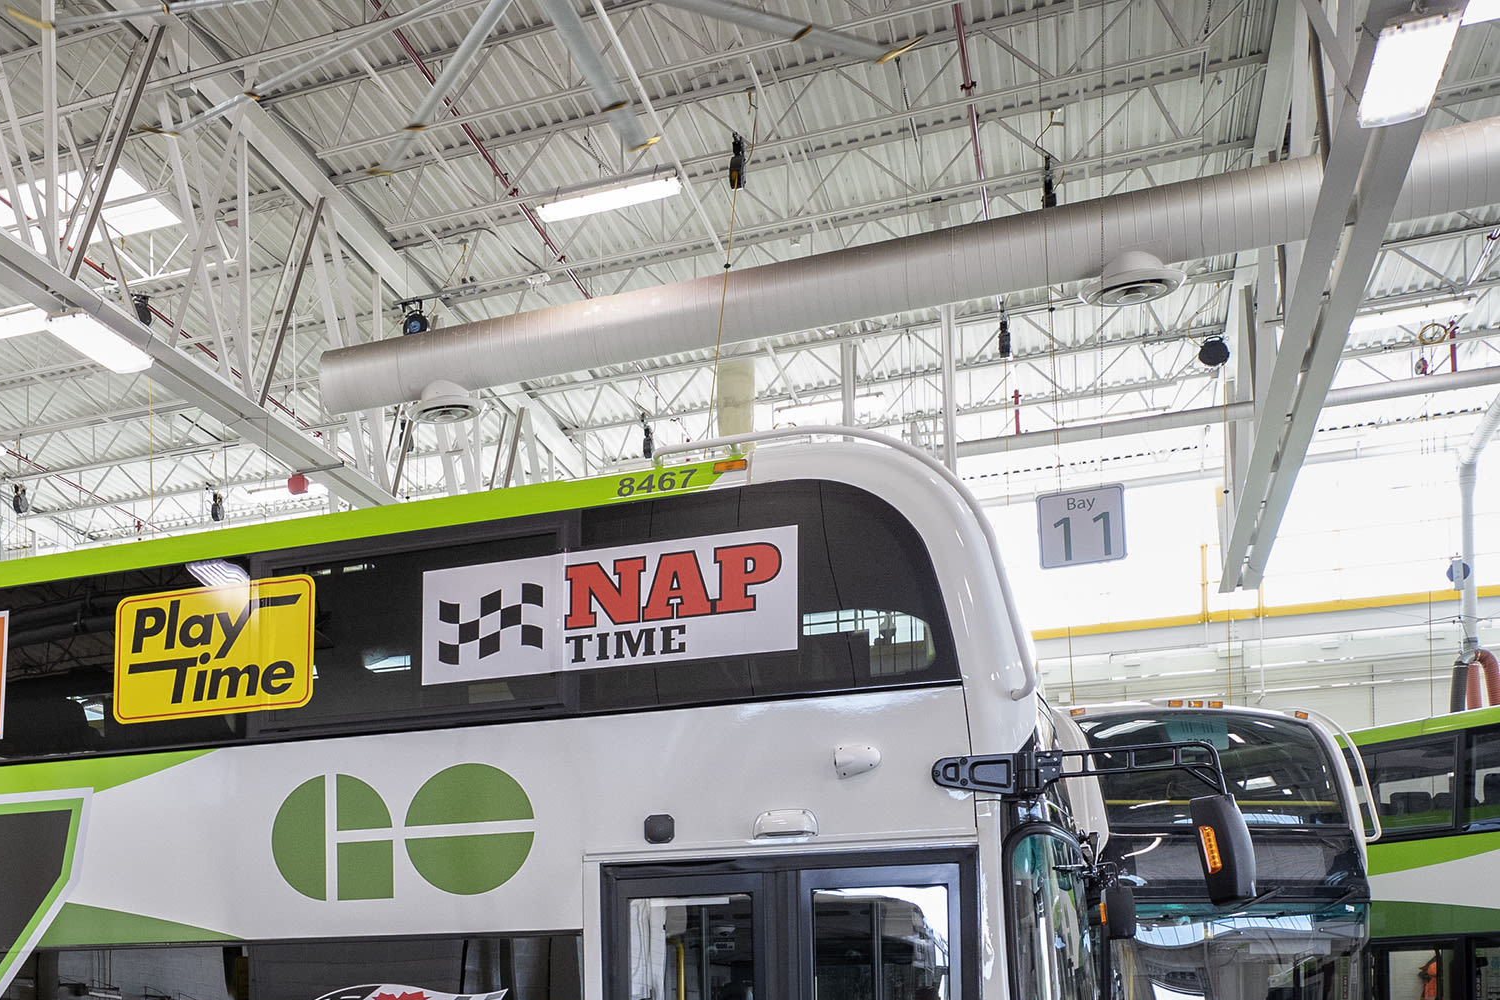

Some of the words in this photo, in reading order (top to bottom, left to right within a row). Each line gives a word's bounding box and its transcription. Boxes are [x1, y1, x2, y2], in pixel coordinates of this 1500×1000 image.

[617, 468, 698, 497] 8467
[1066, 497, 1096, 512] Bay
[1053, 511, 1112, 561] 11
[564, 542, 783, 630] NAP
[131, 593, 303, 660] Play
[565, 625, 687, 664] TIME
[128, 652, 296, 705] Time
[271, 762, 535, 902] GO
